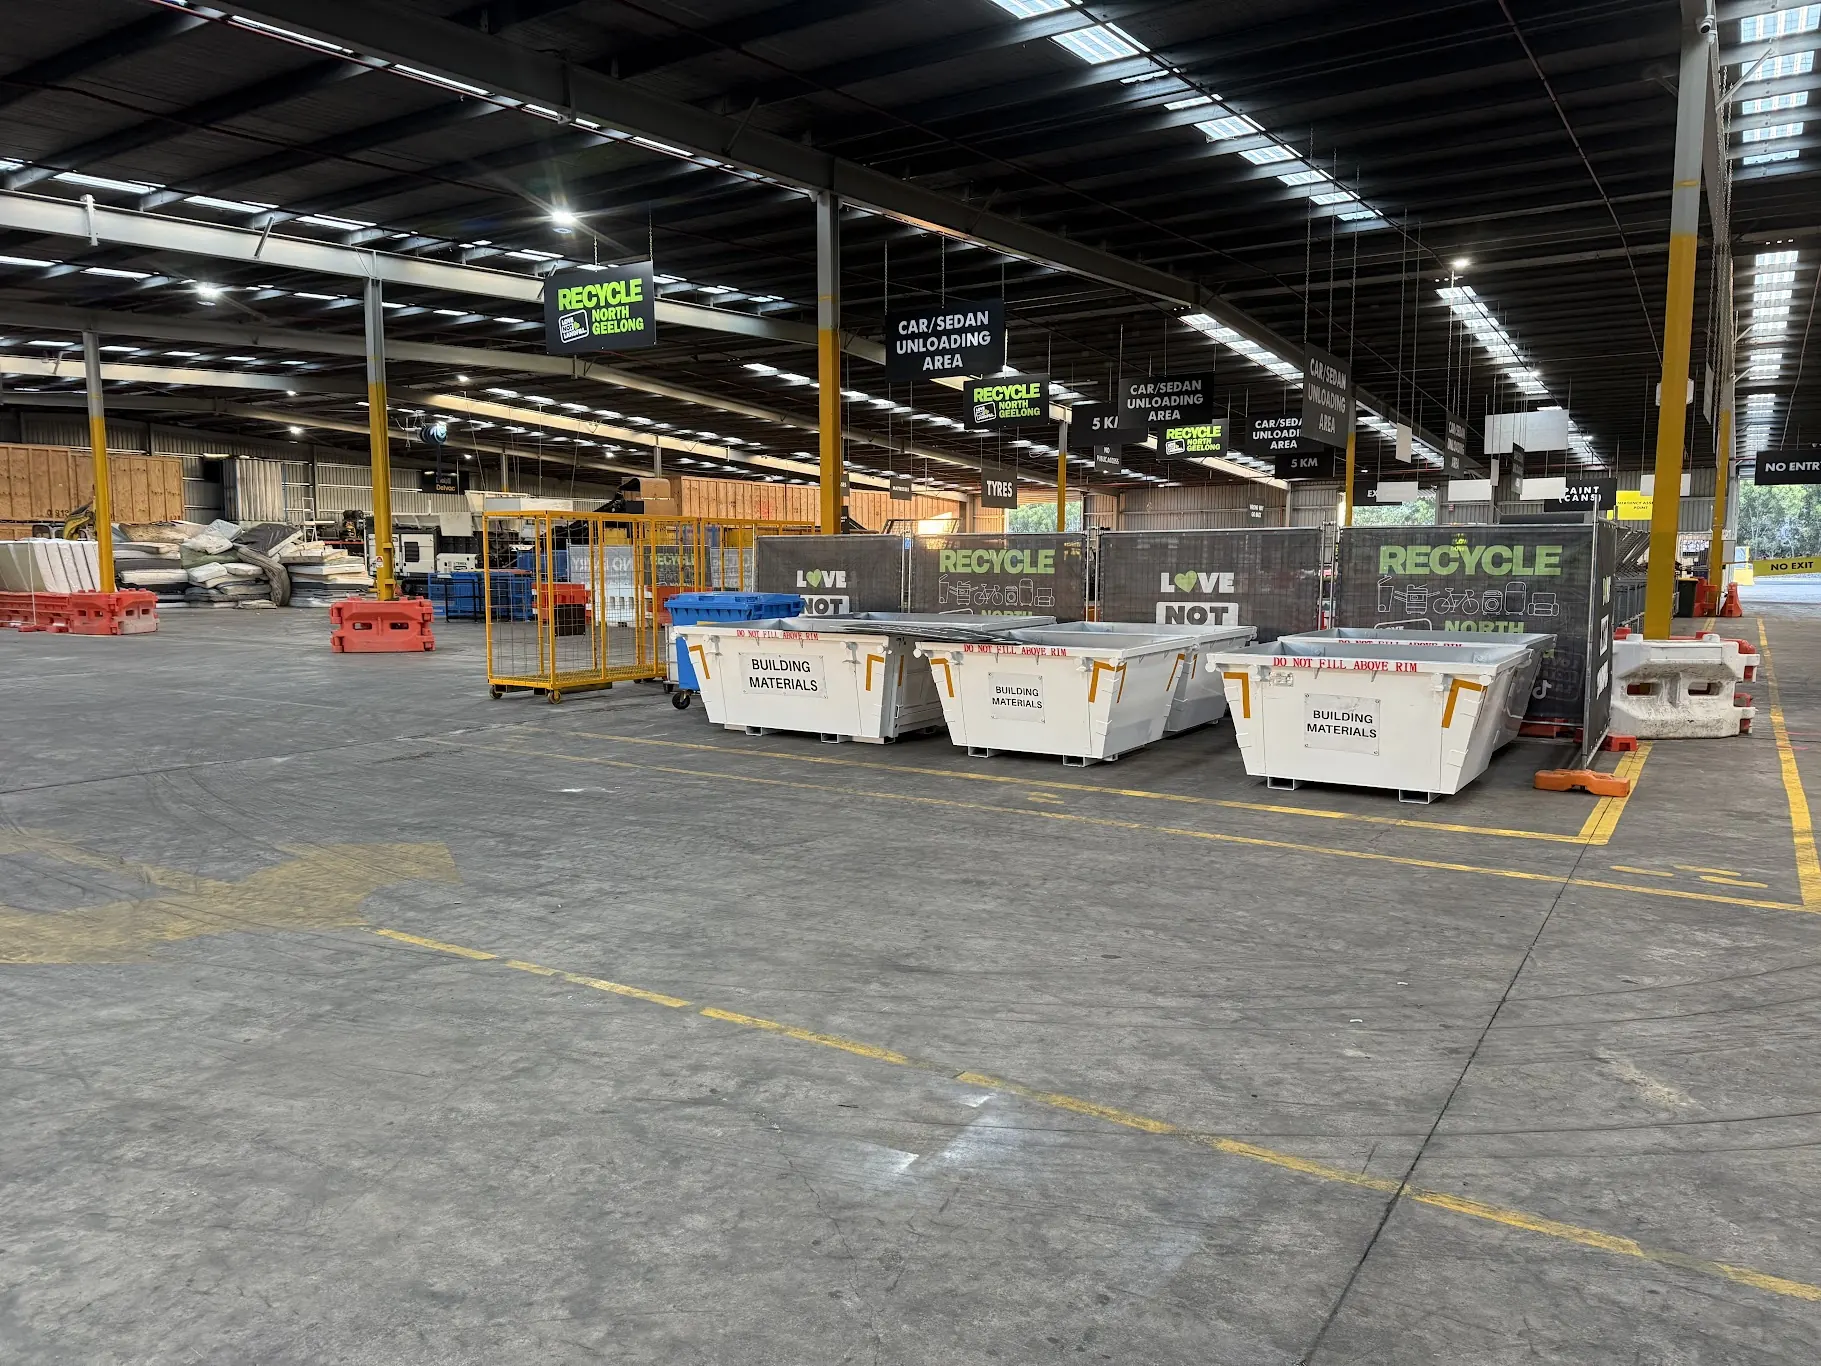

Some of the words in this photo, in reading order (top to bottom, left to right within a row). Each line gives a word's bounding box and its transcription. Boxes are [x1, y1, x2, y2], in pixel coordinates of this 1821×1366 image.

[557, 278, 643, 311] RECYCLE
[592, 305, 629, 322] NORTH
[592, 318, 644, 335] GEELONG
[898, 311, 989, 335] CAR/SEDAN
[896, 330, 991, 355] UNLOADING
[922, 354, 963, 371] AREA
[1309, 357, 1347, 391] CAR/SEDAN
[973, 383, 1041, 403] RECYCLE
[1130, 379, 1202, 396] CAR/SEDAN
[998, 400, 1029, 410] NORTH
[1127, 393, 1204, 410] UNLOADING
[1307, 383, 1346, 414] UNLOADING
[998, 407, 1041, 418] GEELONG
[1147, 410, 1181, 422] AREA
[1091, 417, 1101, 430] 5
[1318, 412, 1336, 435] AREA
[1166, 425, 1222, 440] RECYCLE
[1252, 429, 1302, 440] UNLOADI
[1186, 444, 1221, 452] GEELONG
[1269, 440, 1298, 450] AREA
[1290, 458, 1298, 468] 5
[1299, 457, 1318, 468] KM
[1765, 462, 1786, 472] NO
[1789, 461, 1821, 471] ENTR
[986, 480, 1013, 498] TYRES
[1367, 489, 1379, 498] EX
[1565, 486, 1600, 495] PAINT
[938, 548, 1055, 575] RECYCLE
[1379, 545, 1563, 576] RECYCLE
[1770, 563, 1789, 571] NO
[1791, 561, 1814, 570] EXIT
[800, 598, 843, 615] NOT
[1165, 605, 1229, 625] NOT
[1444, 620, 1525, 634] NORTH
[736, 630, 745, 638] DO
[747, 630, 760, 639] NOT
[762, 631, 779, 640] FILL
[782, 632, 804, 641] ABOVE
[805, 633, 819, 641] RIM
[963, 644, 975, 653] DO
[977, 645, 993, 654] NOT
[996, 645, 1017, 655] FILL
[1021, 646, 1048, 656] ABOVE
[1050, 647, 1067, 657] RIM
[751, 658, 811, 673] BUILDING
[1273, 657, 1287, 667] DO
[1293, 658, 1313, 669] NOT
[1319, 659, 1347, 670] FILL
[1353, 660, 1389, 672] ABOVE
[1395, 662, 1418, 673] RIM
[748, 676, 818, 692] MATERIALS
[995, 685, 1039, 697] BUILDING
[992, 697, 1043, 710] MATERIALS
[1312, 710, 1373, 725] BUILDING
[1306, 723, 1377, 739] MATERIALS
